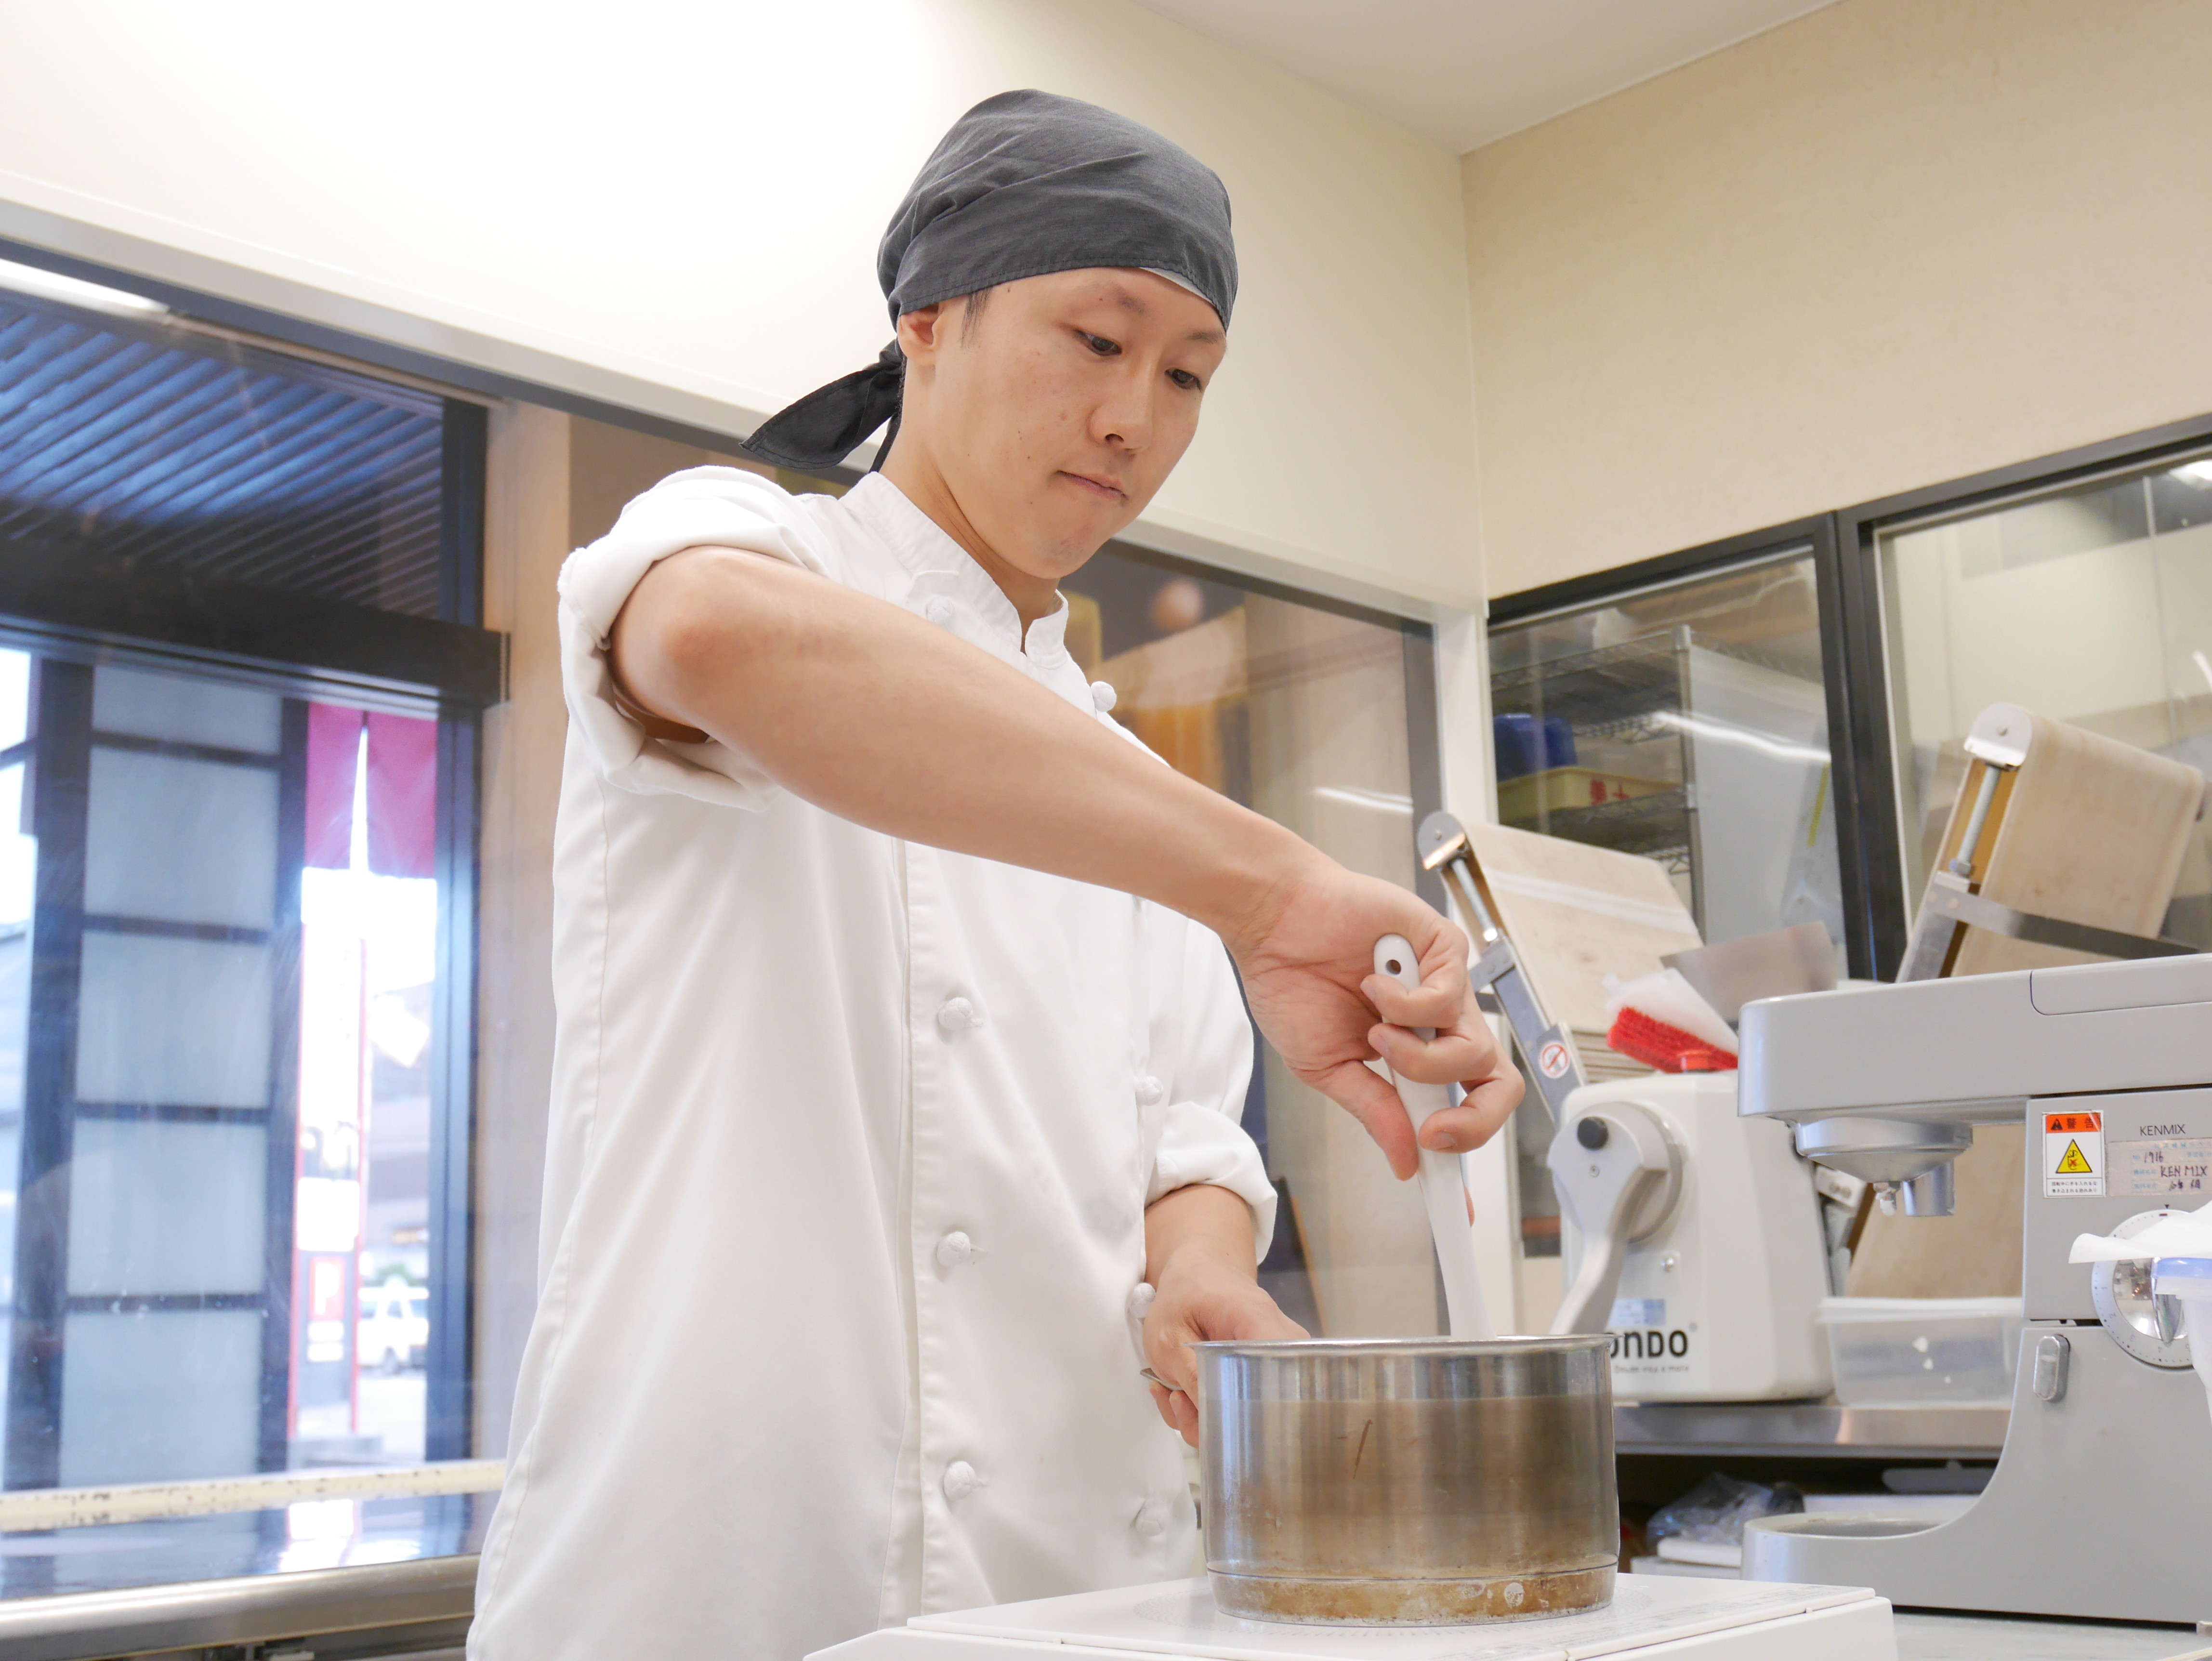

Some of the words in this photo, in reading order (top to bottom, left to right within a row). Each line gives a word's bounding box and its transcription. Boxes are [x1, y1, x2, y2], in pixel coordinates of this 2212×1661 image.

[2067, 1117, 2094, 1130] 警告
[2140, 1124, 2186, 1136] KENMIX
[2160, 1165, 2181, 1177] KEN
[2185, 1165, 2208, 1176] MIX
